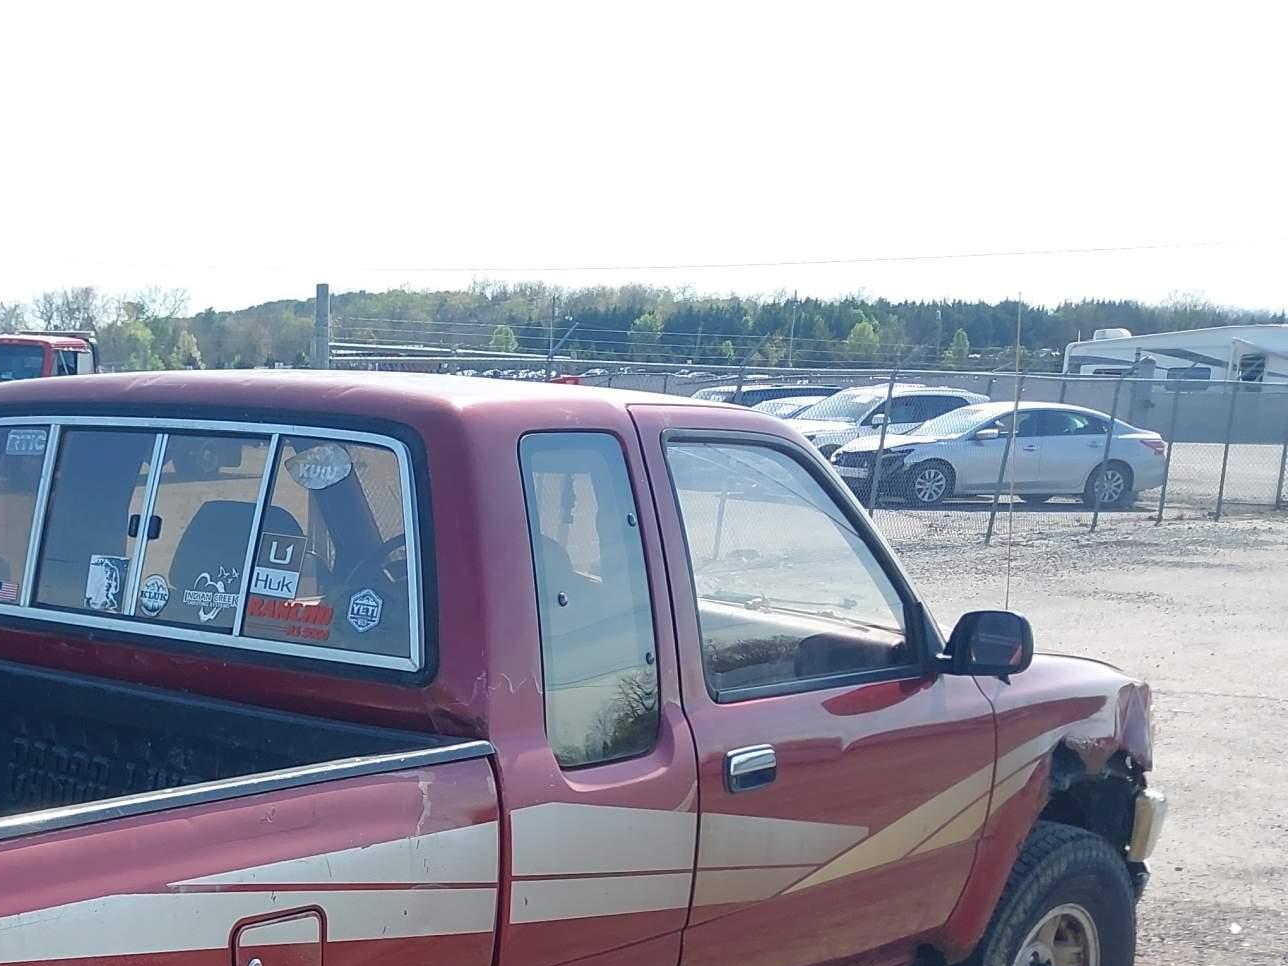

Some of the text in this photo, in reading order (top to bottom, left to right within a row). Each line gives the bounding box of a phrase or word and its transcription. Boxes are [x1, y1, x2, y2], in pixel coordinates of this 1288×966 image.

[7, 434, 47, 451] RTIC
[254, 572, 294, 594] Huk
[184, 590, 241, 608] INDIAN CREEK
[353, 603, 378, 617] YETI
